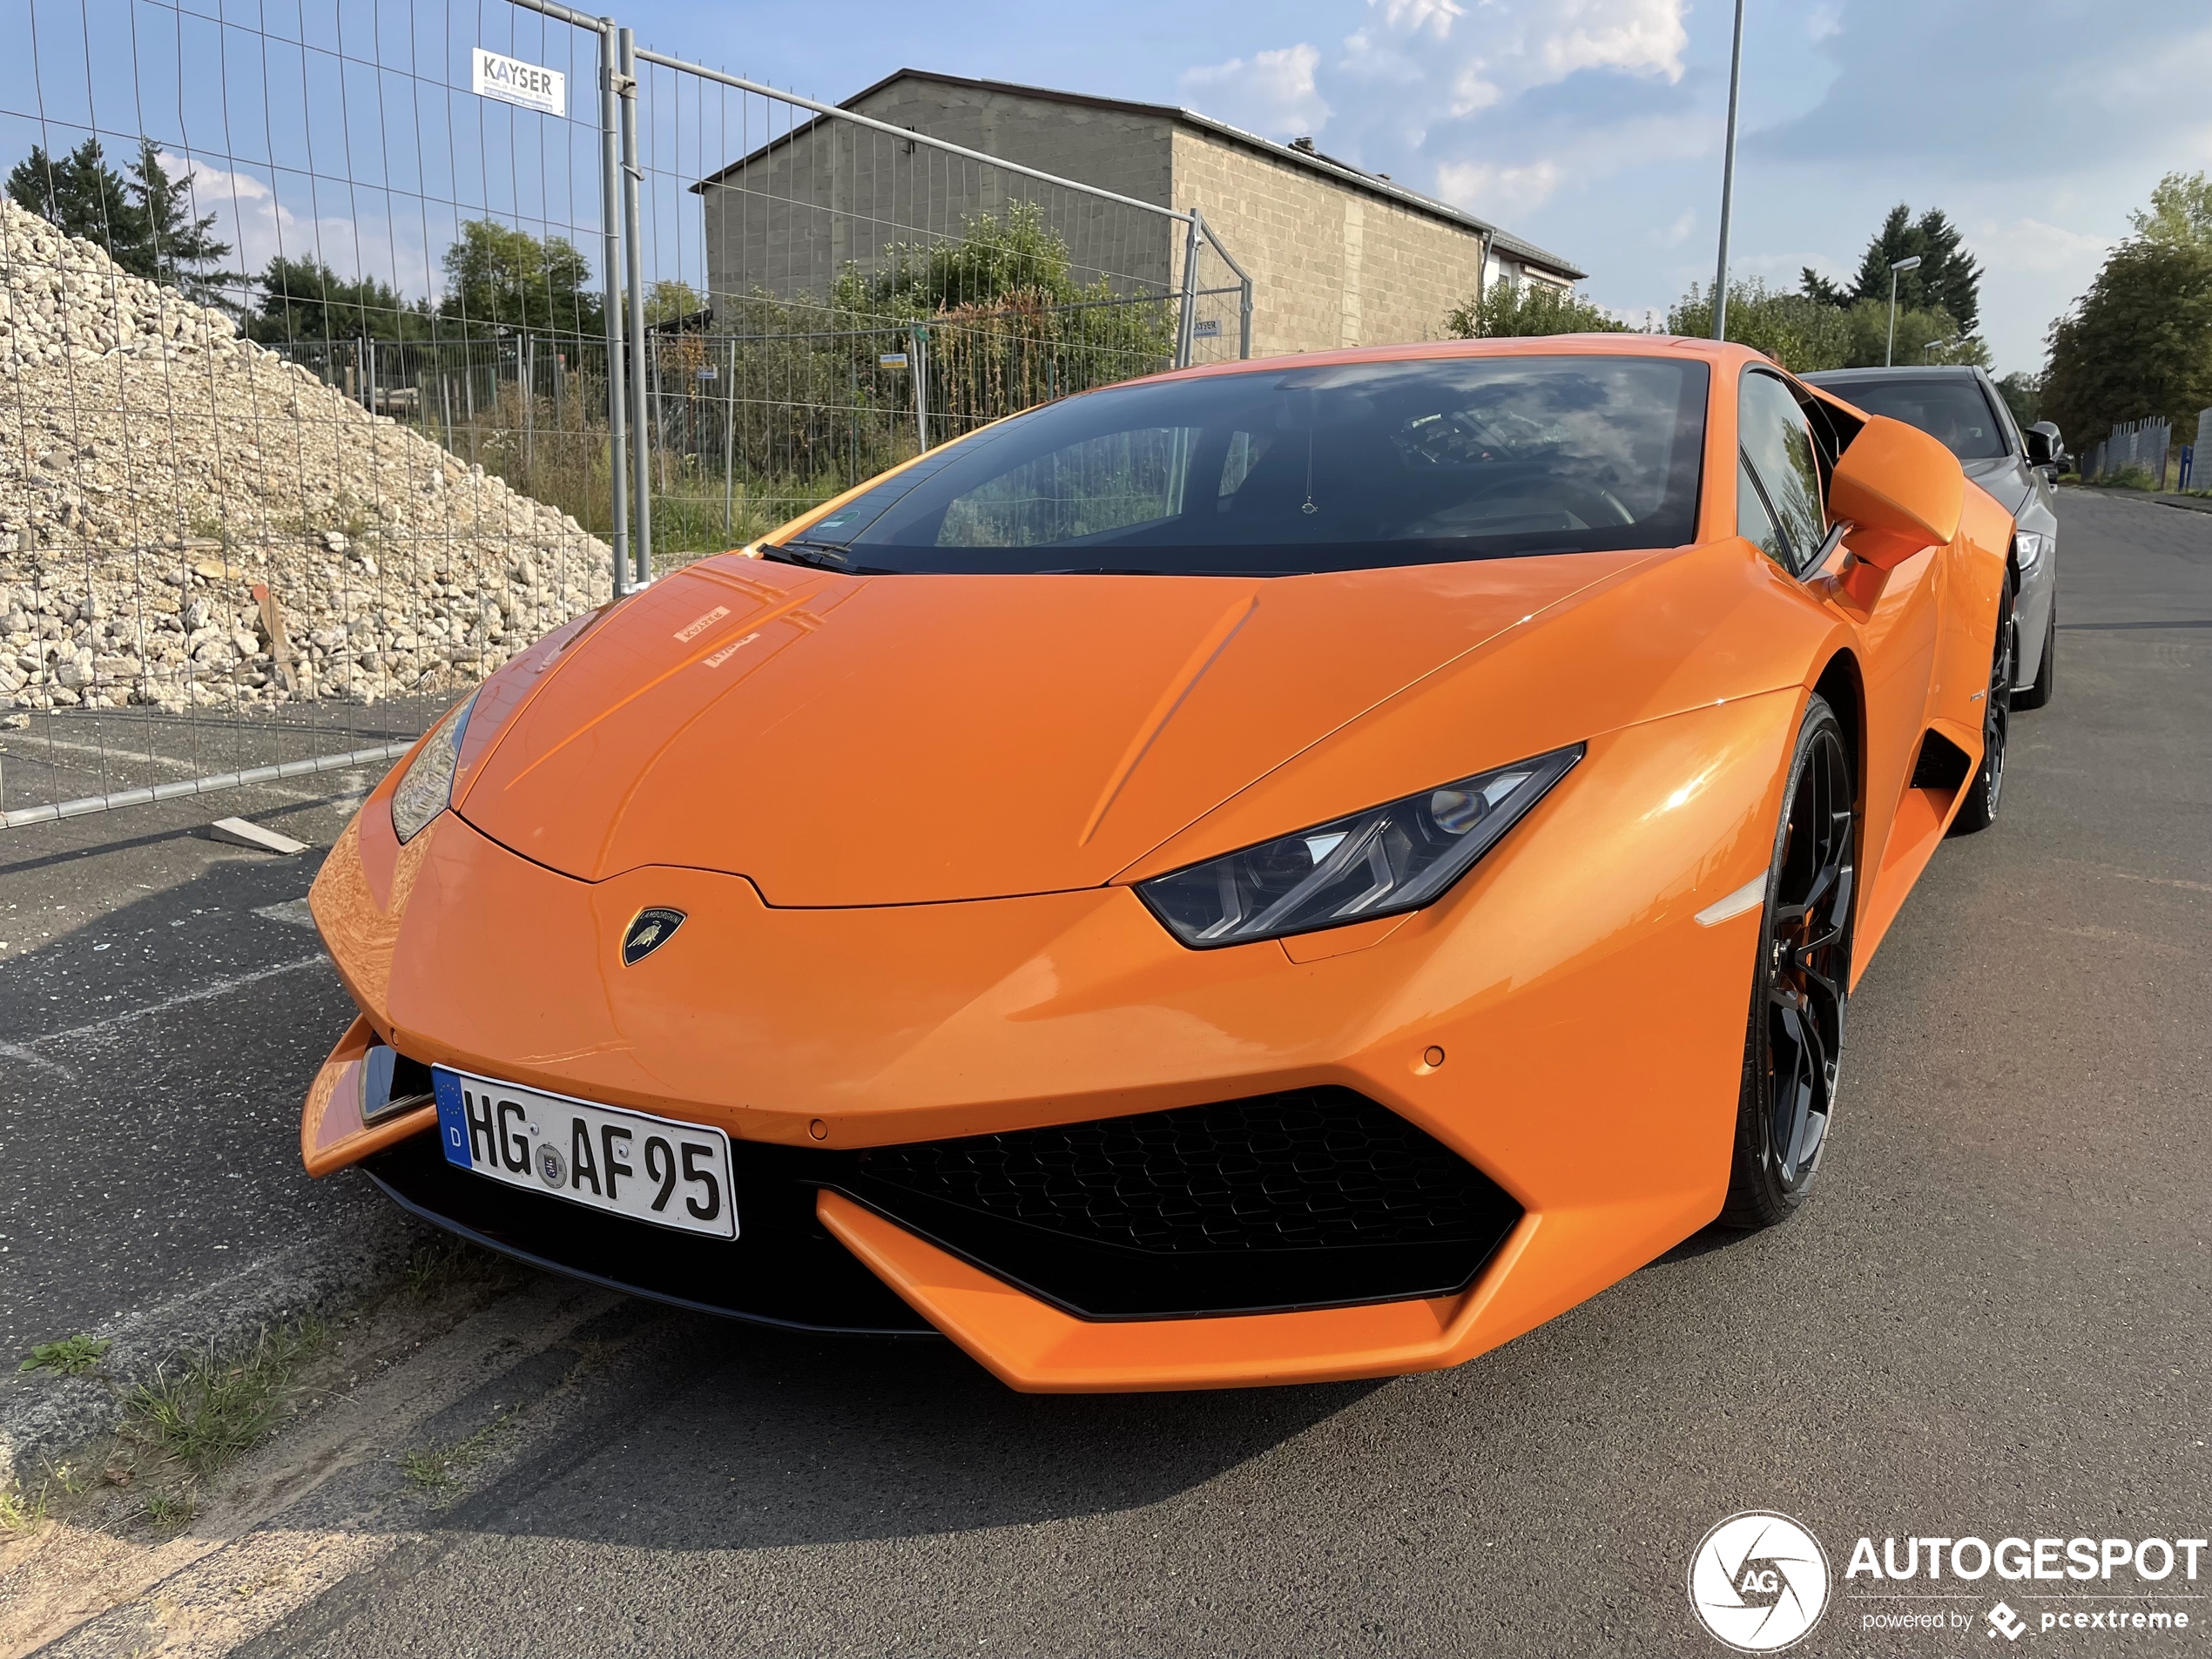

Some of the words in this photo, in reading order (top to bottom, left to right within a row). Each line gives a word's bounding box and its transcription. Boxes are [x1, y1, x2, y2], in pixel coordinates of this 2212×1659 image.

[484, 56, 552, 96] KAYSER
[1194, 320, 1217, 331] AYSER
[640, 911, 681, 925] LAMBORGHINI
[450, 1126, 461, 1147] D
[464, 1090, 531, 1175] HG
[571, 1117, 633, 1199] AF
[644, 1136, 720, 1221] 95
